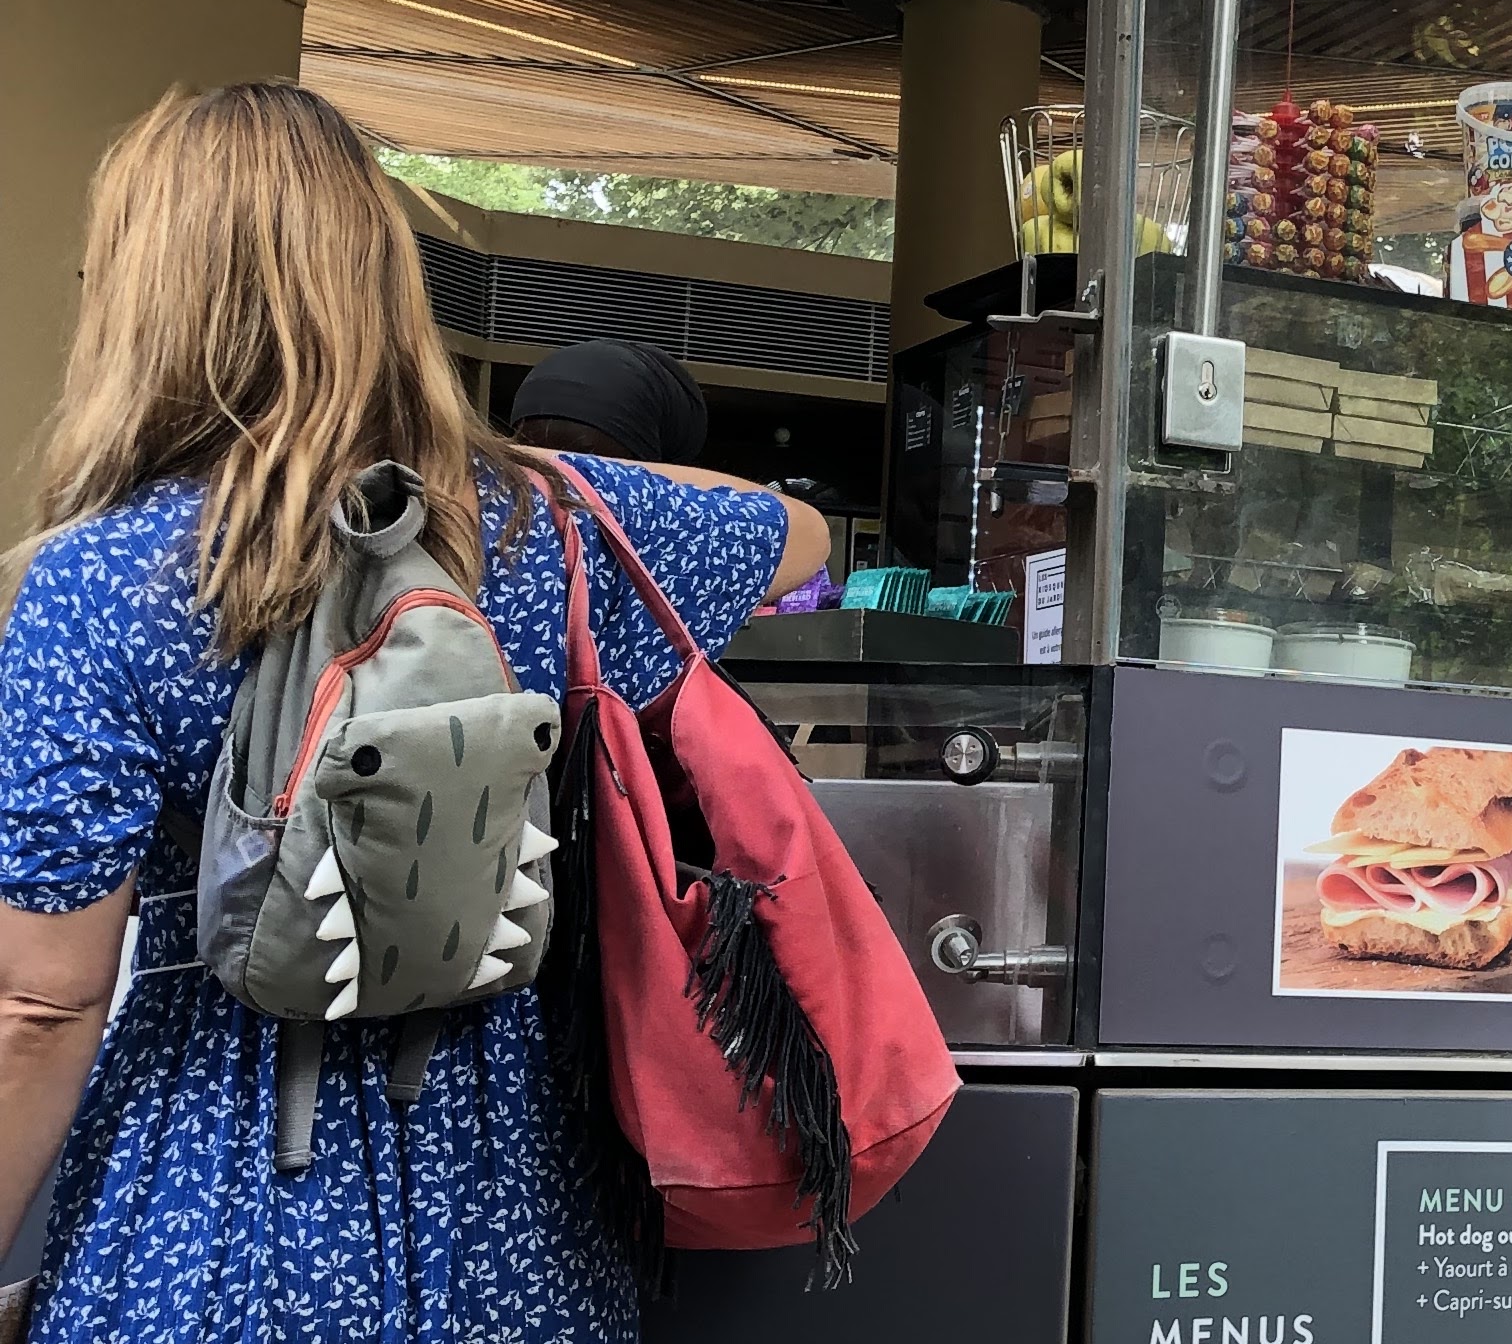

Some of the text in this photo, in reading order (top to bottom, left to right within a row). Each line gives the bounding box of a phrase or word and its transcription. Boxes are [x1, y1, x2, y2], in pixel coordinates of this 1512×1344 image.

[1419, 1188, 1503, 1213] MENU
[1418, 1223, 1456, 1246] Hot
[1459, 1223, 1494, 1253] dog
[1152, 1261, 1228, 1299] LES
[1433, 1256, 1494, 1279] Yaourt
[1497, 1255, 1508, 1277] à
